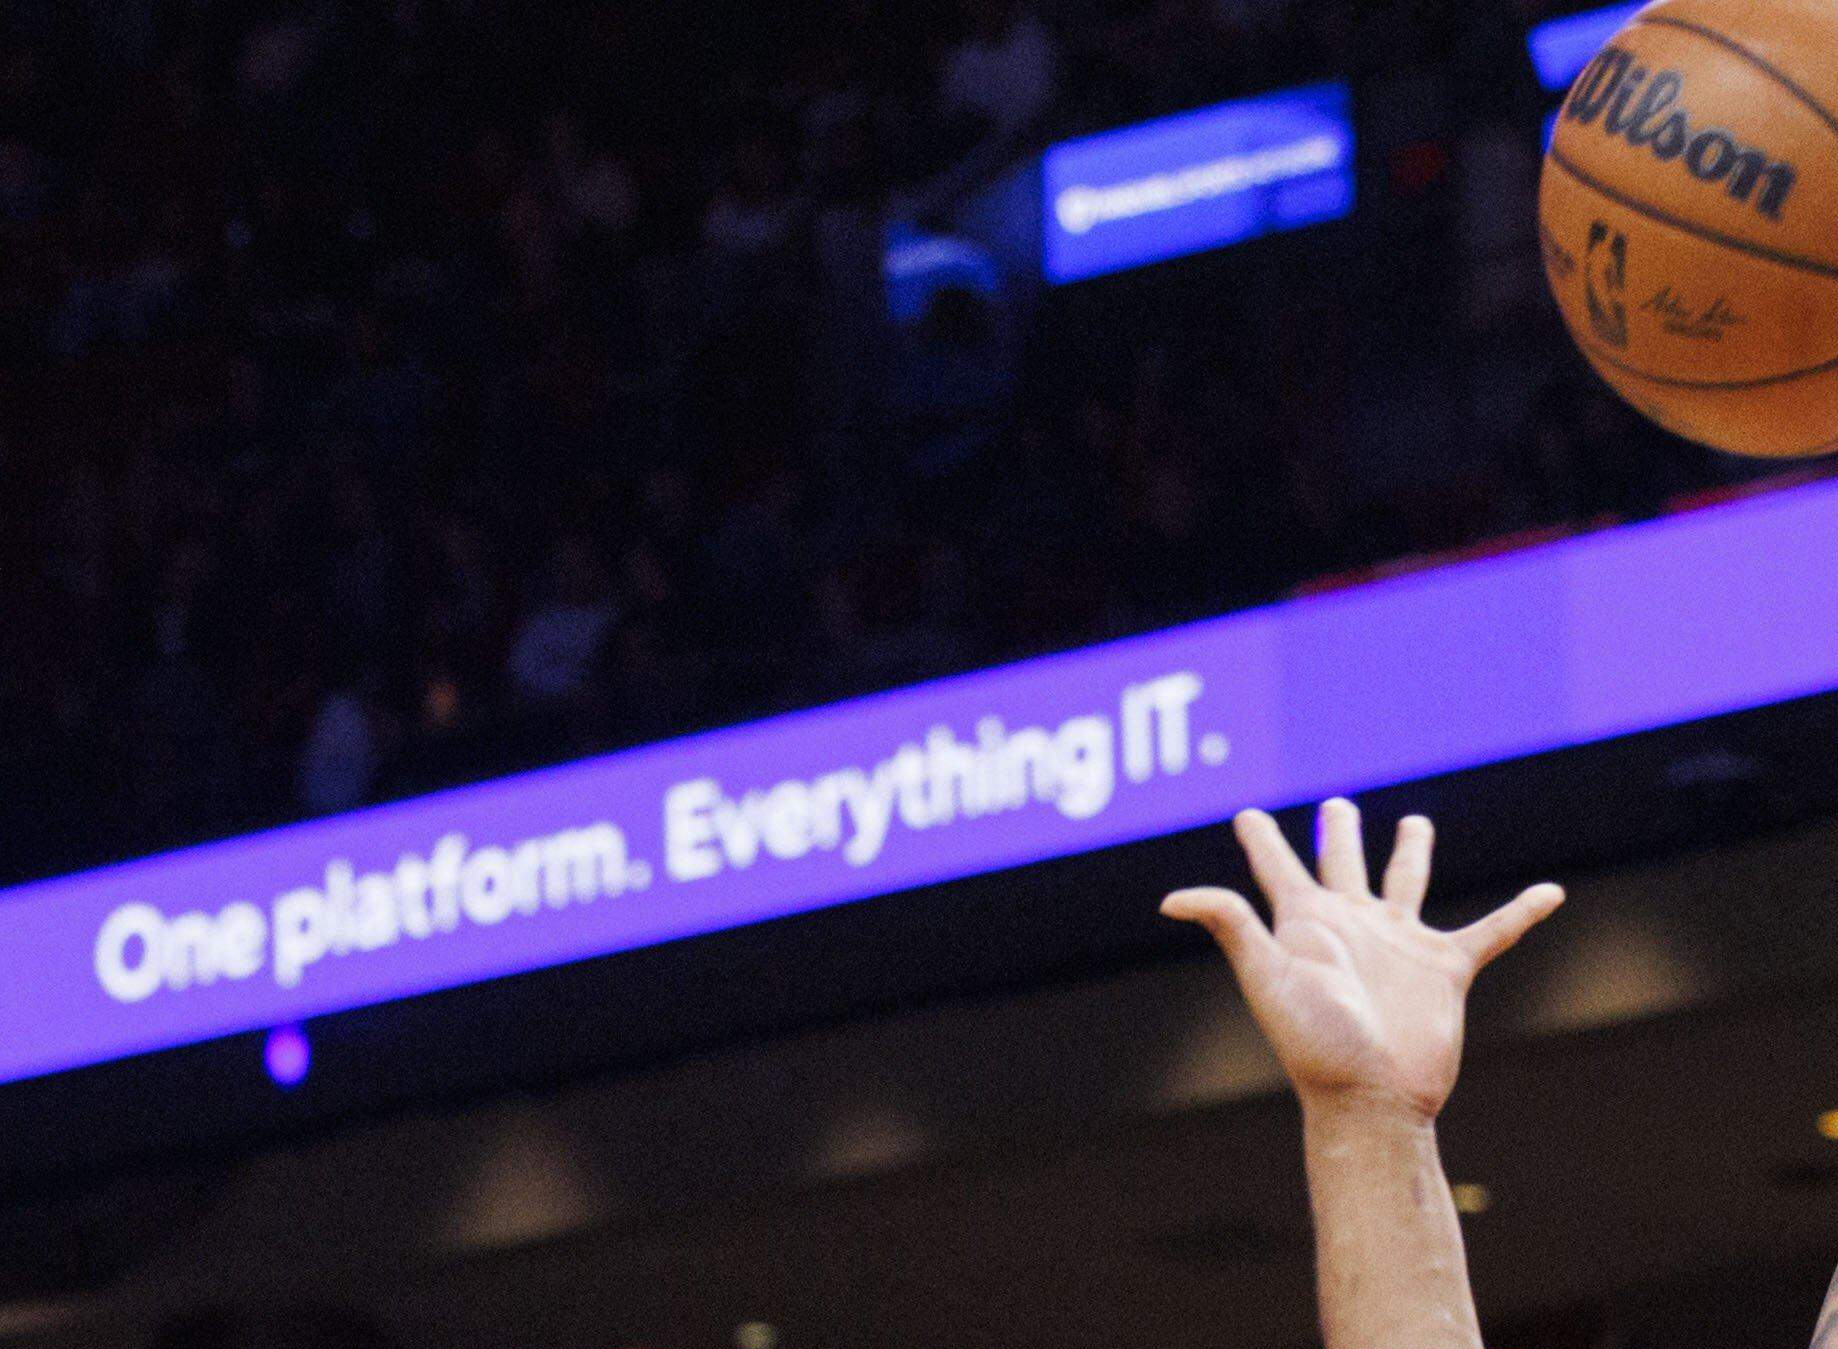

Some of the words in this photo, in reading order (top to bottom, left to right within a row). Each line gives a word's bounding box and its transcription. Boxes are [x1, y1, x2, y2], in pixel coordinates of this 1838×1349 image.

[1567, 46, 1797, 223] Wilson
[94, 895, 266, 1003] One
[269, 818, 651, 988] platform.
[662, 704, 1114, 882] Everything
[1118, 670, 1229, 784] IT.
